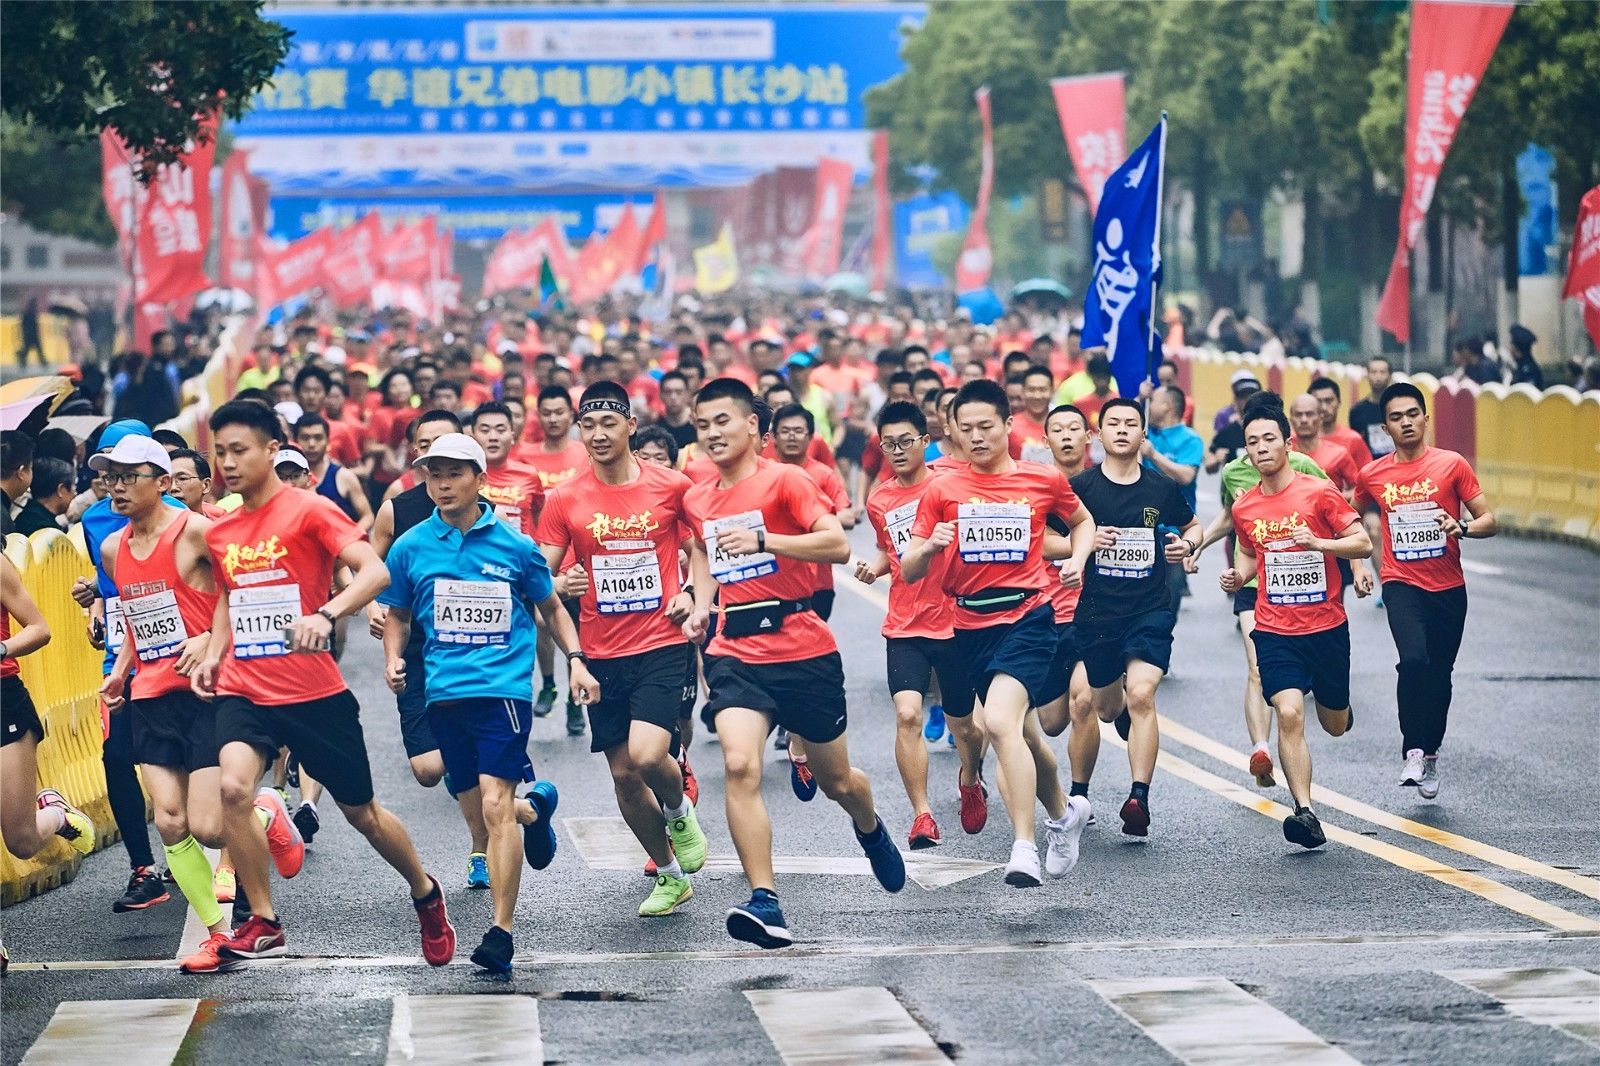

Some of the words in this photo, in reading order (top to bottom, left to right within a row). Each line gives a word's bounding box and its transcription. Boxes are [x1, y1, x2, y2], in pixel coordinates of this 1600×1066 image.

[966, 527, 1022, 543] A10550
[1395, 529, 1440, 544] A12888
[1100, 548, 1149, 562] A12890
[600, 575, 654, 594] A10418
[1271, 571, 1319, 587] A12889
[441, 606, 503, 624] A13397
[134, 617, 177, 641] A13453
